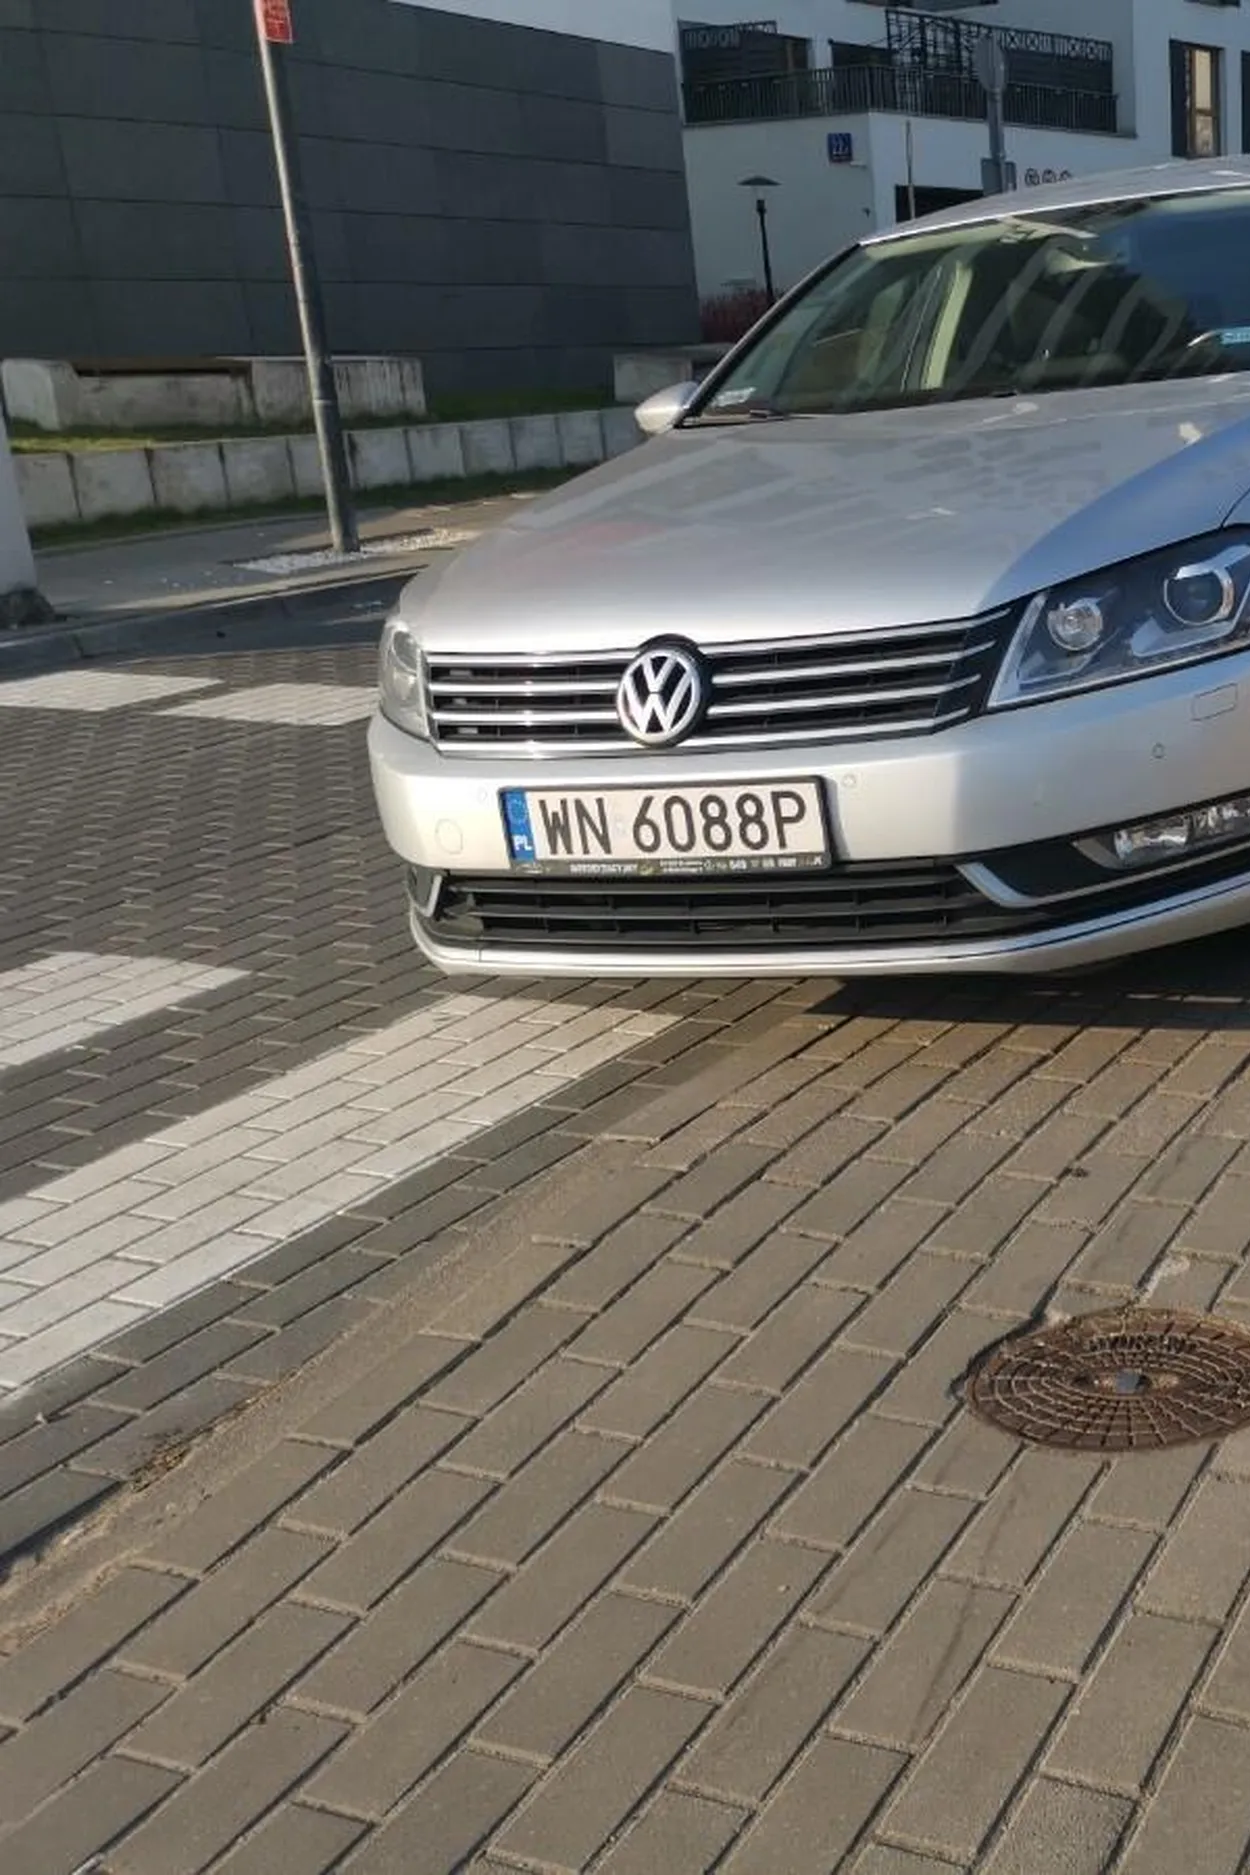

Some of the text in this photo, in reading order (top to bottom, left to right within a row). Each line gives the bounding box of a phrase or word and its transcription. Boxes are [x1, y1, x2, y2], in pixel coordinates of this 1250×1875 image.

[513, 834, 533, 852] PL
[538, 789, 807, 856] WN 6088P
